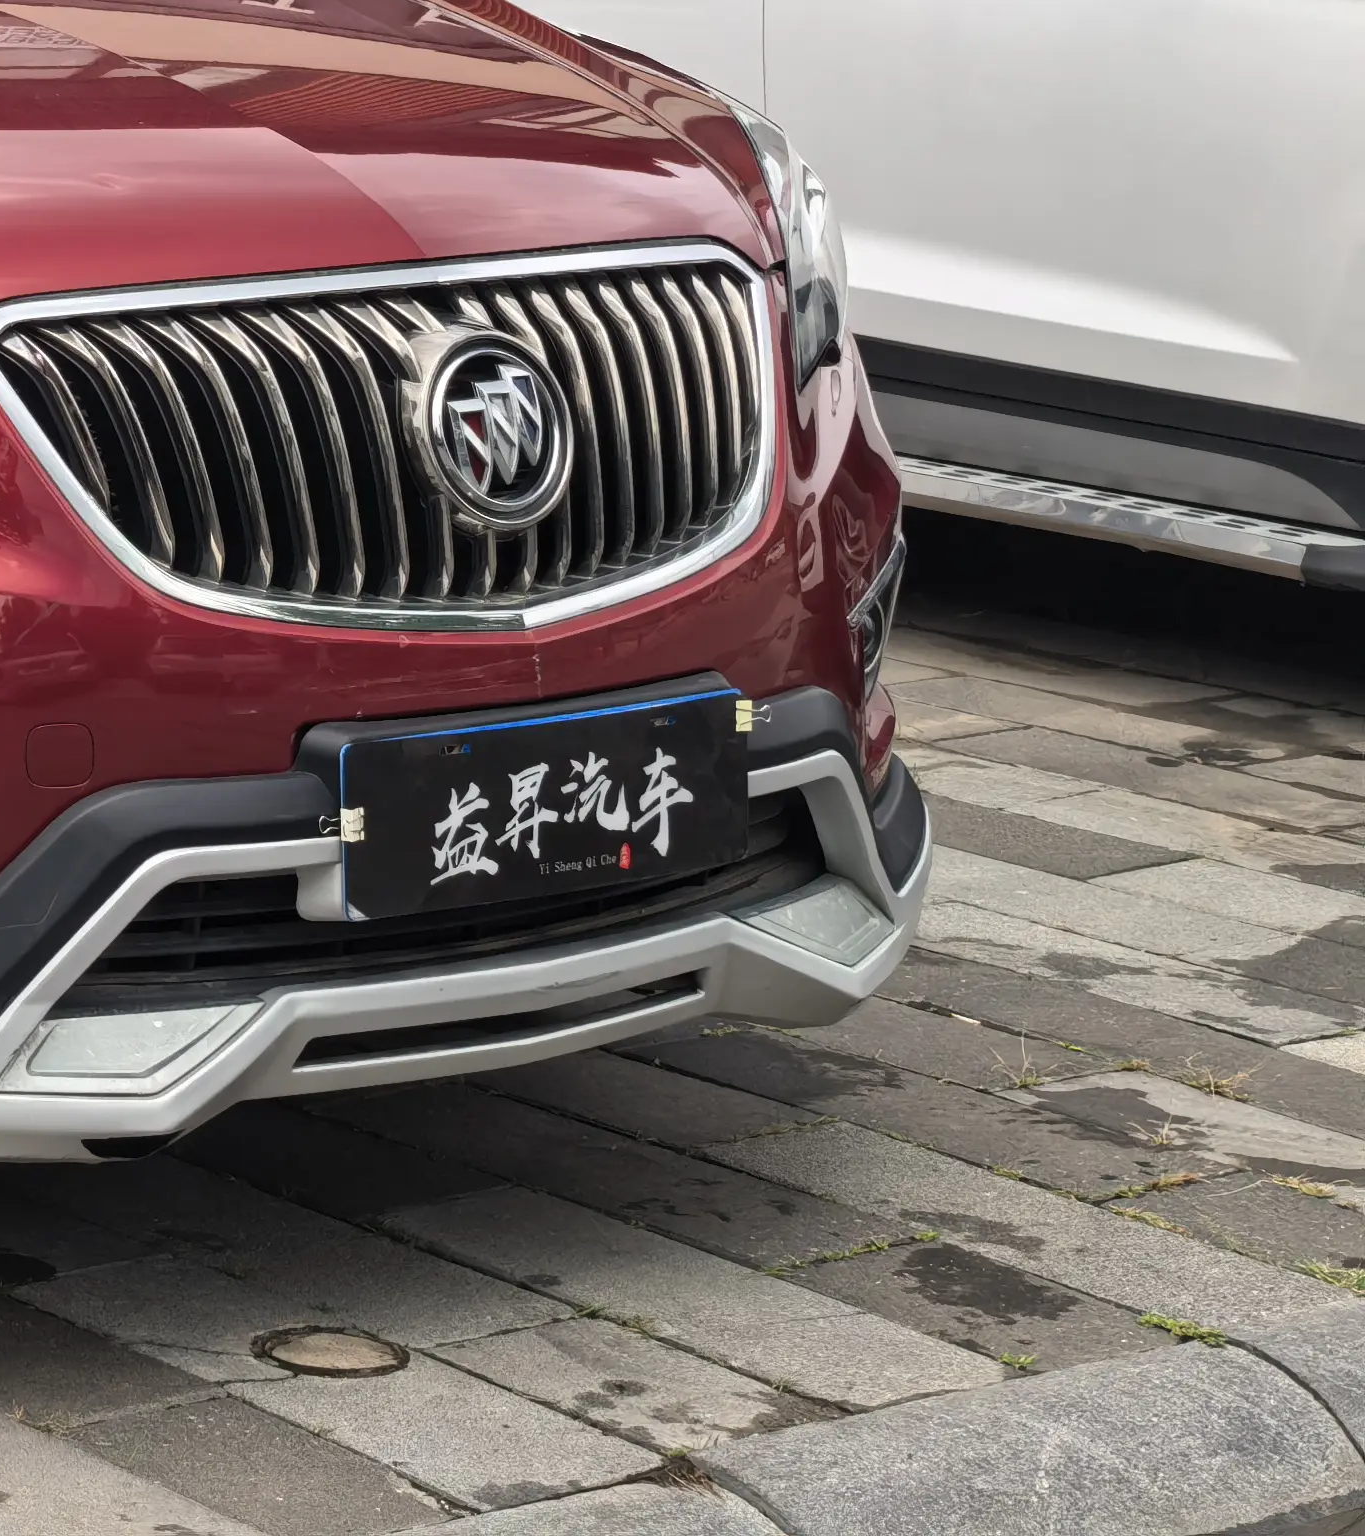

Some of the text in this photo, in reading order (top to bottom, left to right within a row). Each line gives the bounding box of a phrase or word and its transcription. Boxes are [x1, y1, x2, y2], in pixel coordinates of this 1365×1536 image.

[539, 863, 550, 875] Yi
[554, 861, 583, 873] Sheng
[586, 856, 597, 868] Qi
[601, 853, 617, 866] Che
